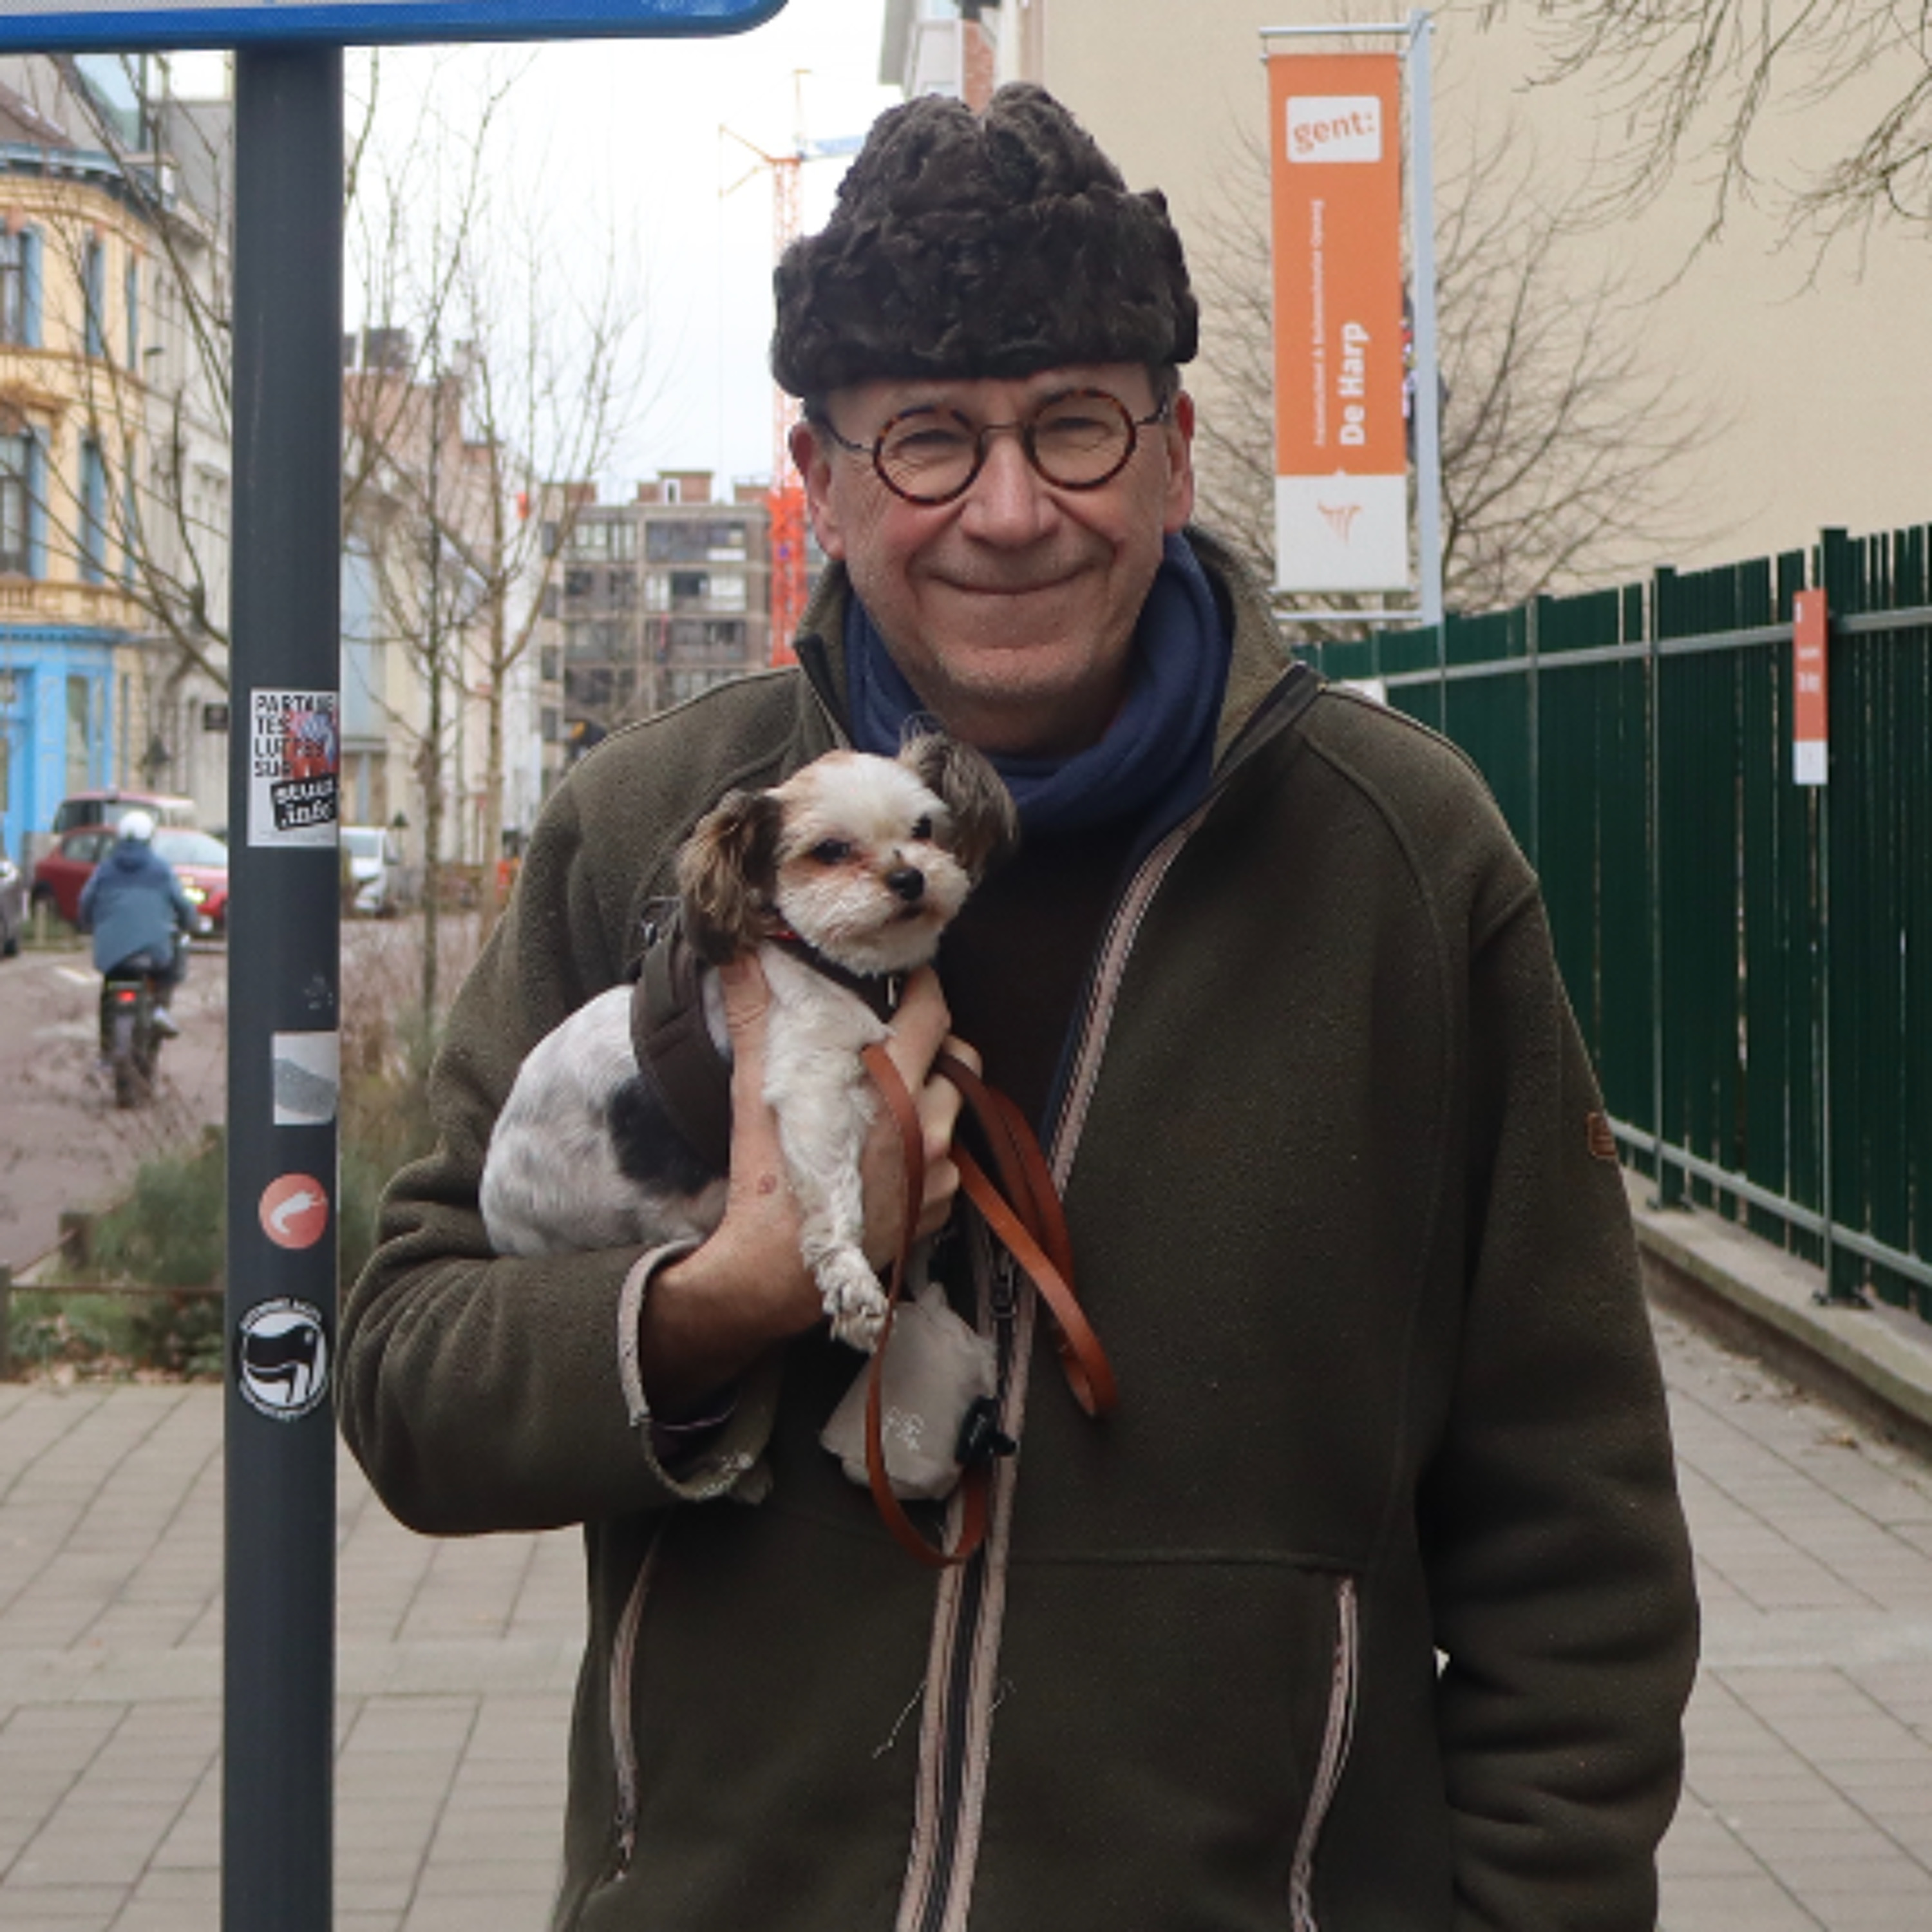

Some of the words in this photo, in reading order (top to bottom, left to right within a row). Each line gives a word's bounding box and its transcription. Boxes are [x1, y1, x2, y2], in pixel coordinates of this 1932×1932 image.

[1294, 111, 1374, 155] gent:
[1338, 321, 1370, 397] Harp
[1340, 404, 1365, 445] De
[256, 714, 291, 734] TES
[255, 760, 293, 777] SUR
